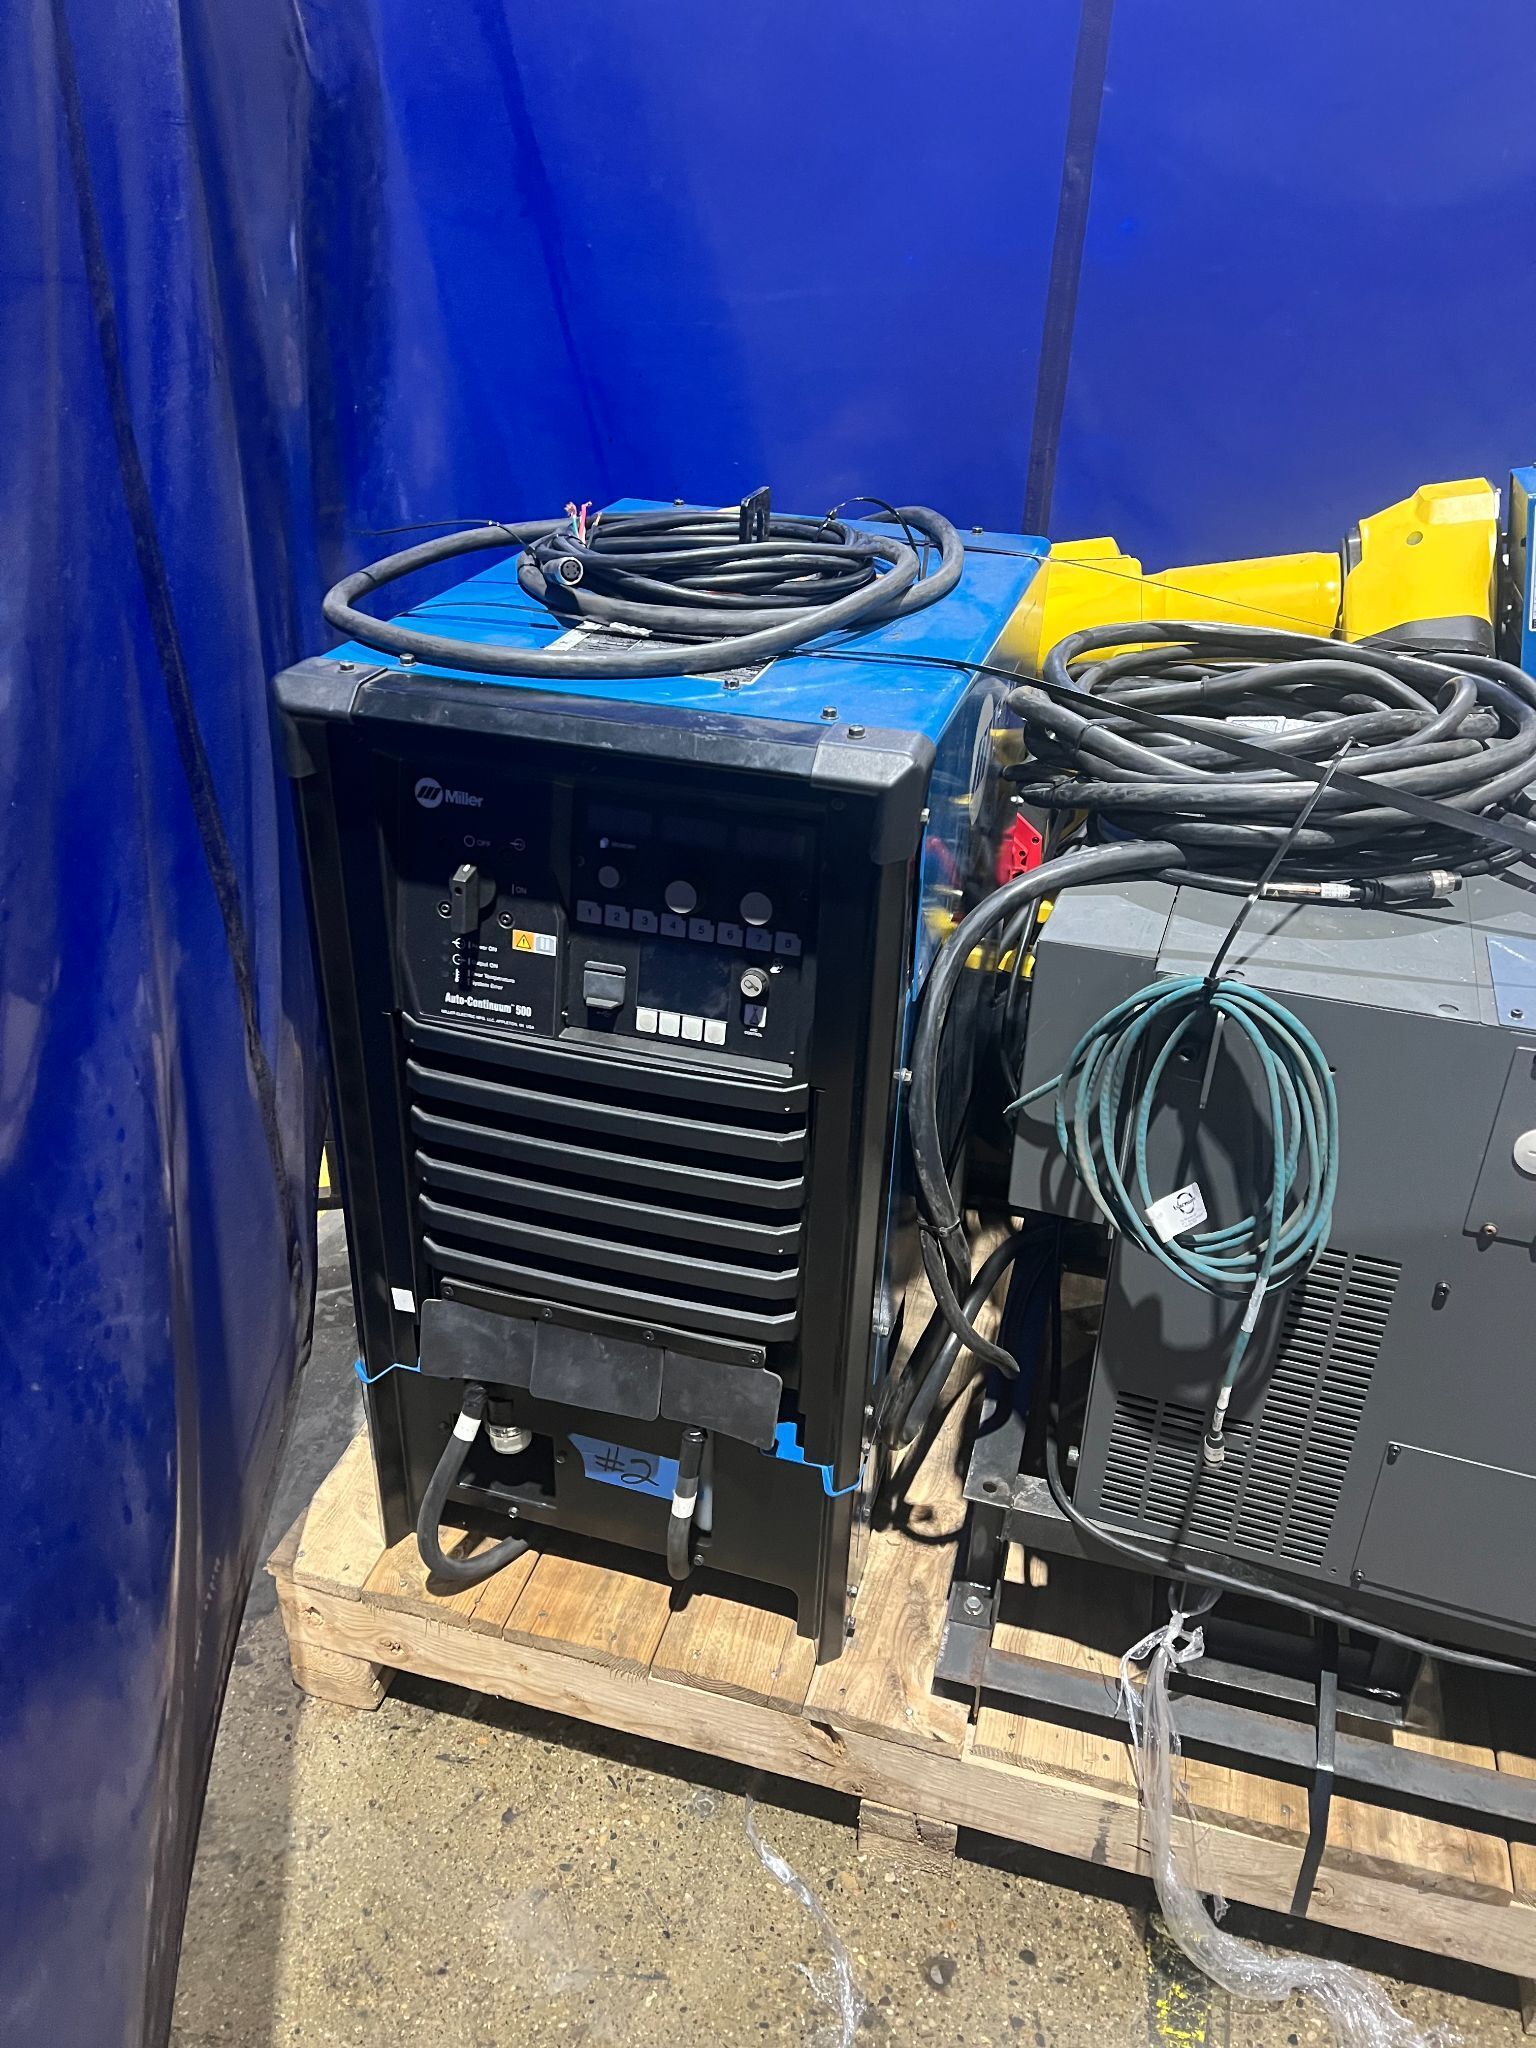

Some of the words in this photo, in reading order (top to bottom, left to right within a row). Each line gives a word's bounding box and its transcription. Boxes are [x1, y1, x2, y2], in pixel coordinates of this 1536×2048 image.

[445, 789, 484, 807] Miller
[476, 839, 491, 847] OFF
[515, 885, 528, 895] ON
[515, 1004, 532, 1018] 500
[595, 1447, 660, 1487] #2
